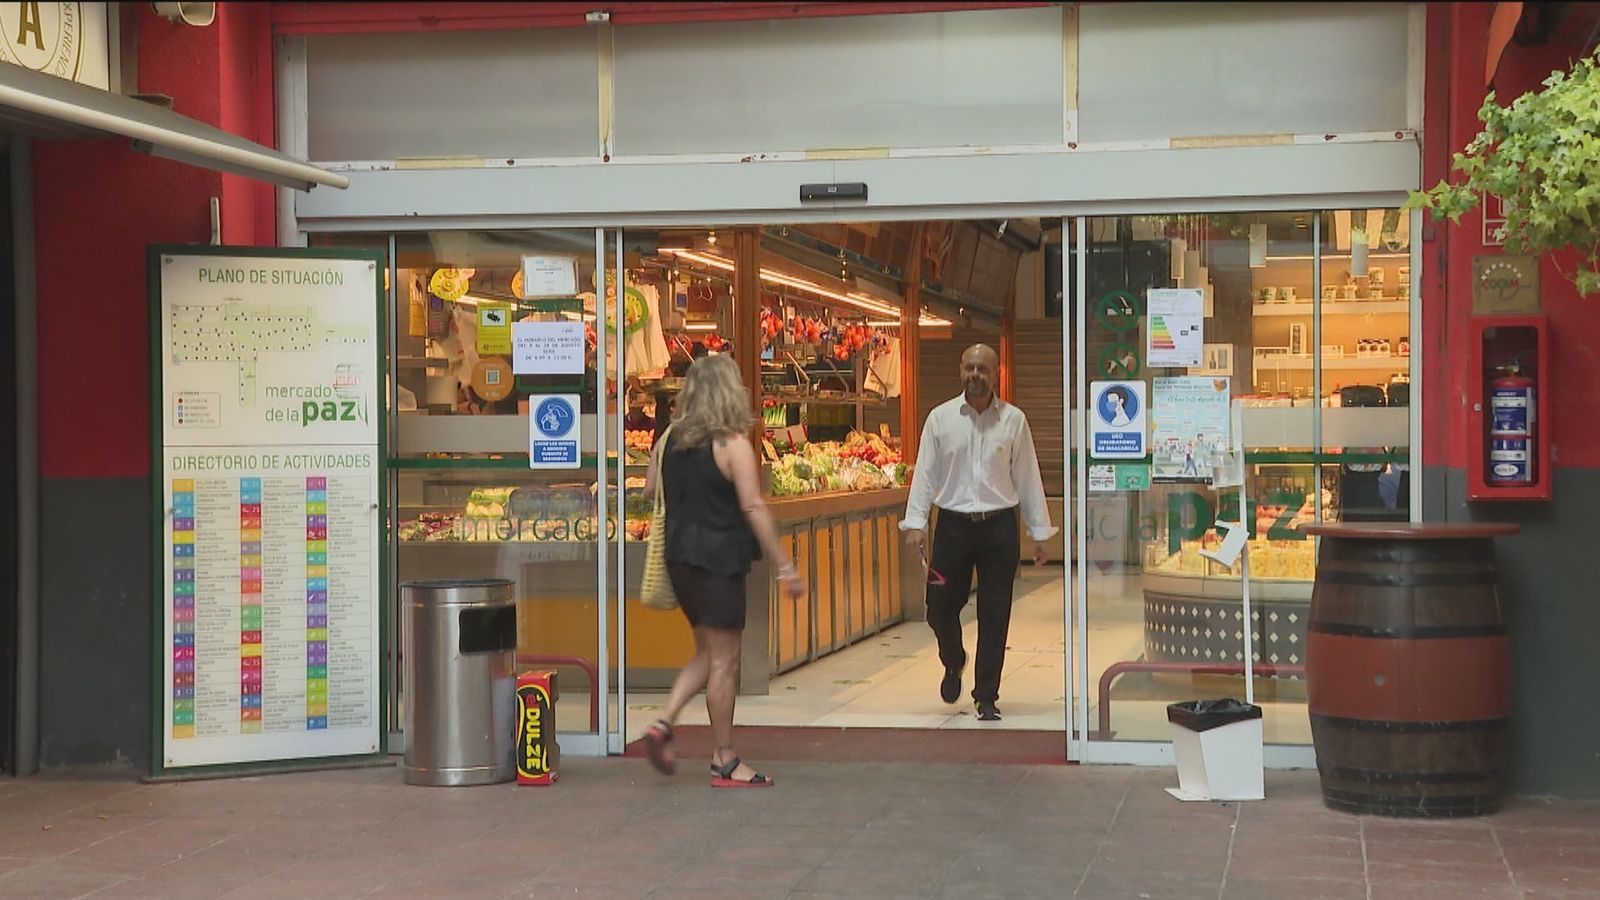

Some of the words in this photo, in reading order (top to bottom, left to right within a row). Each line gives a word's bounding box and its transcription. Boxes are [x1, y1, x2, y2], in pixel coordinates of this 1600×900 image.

[17, 2, 45, 51] A
[199, 268, 245, 283] PLANO
[250, 270, 267, 284] DE
[271, 269, 344, 286] SITUACIÓN
[265, 384, 332, 398] mercado
[265, 407, 284, 422] de
[287, 407, 299, 422] la
[302, 401, 356, 428] paz
[172, 456, 257, 470] DIRECTORIO
[262, 456, 279, 469] DE
[284, 454, 371, 469] ACTIVIDADES
